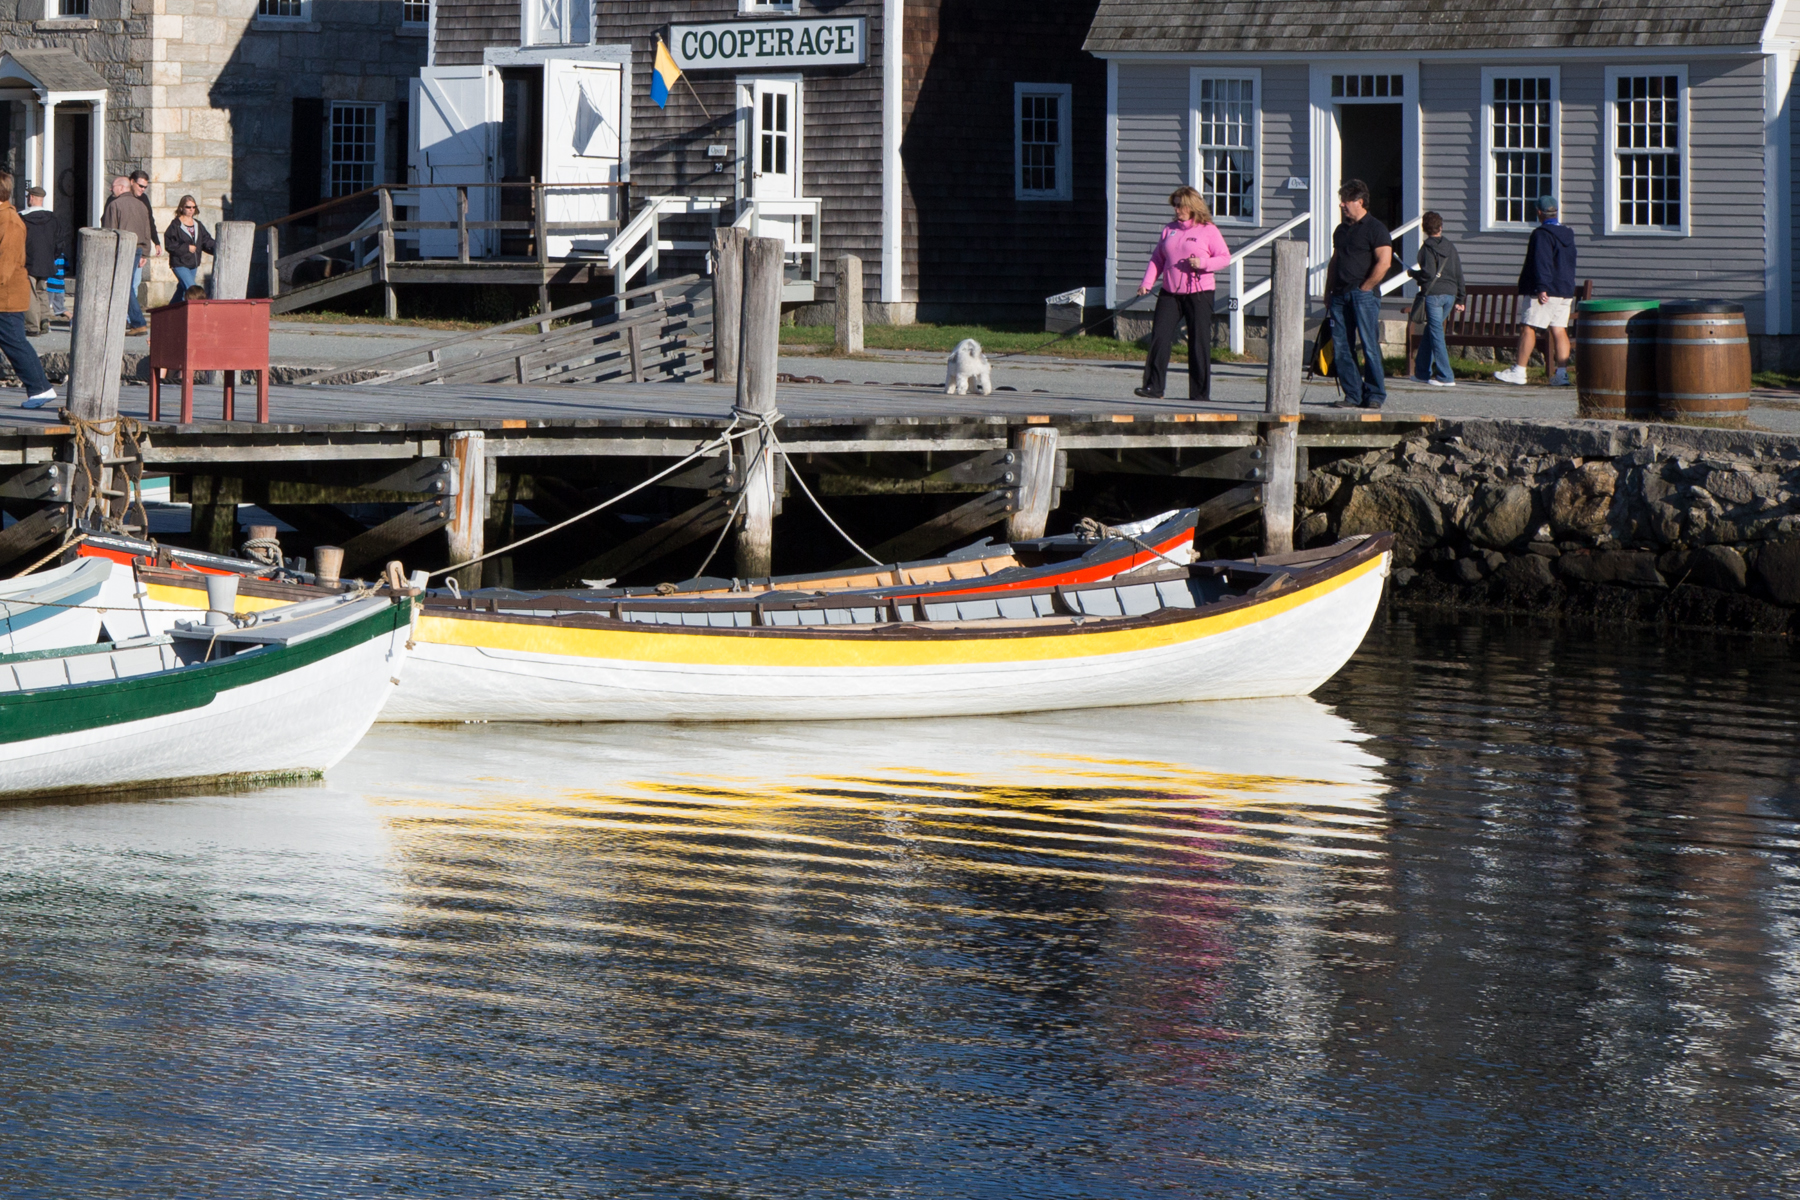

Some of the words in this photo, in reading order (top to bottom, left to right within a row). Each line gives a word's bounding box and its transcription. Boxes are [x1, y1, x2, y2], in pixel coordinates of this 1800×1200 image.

[681, 25, 855, 60] COOPERAGE
[710, 147, 724, 155] Open
[1291, 179, 1305, 188] Open
[1228, 299, 1238, 310] 28
